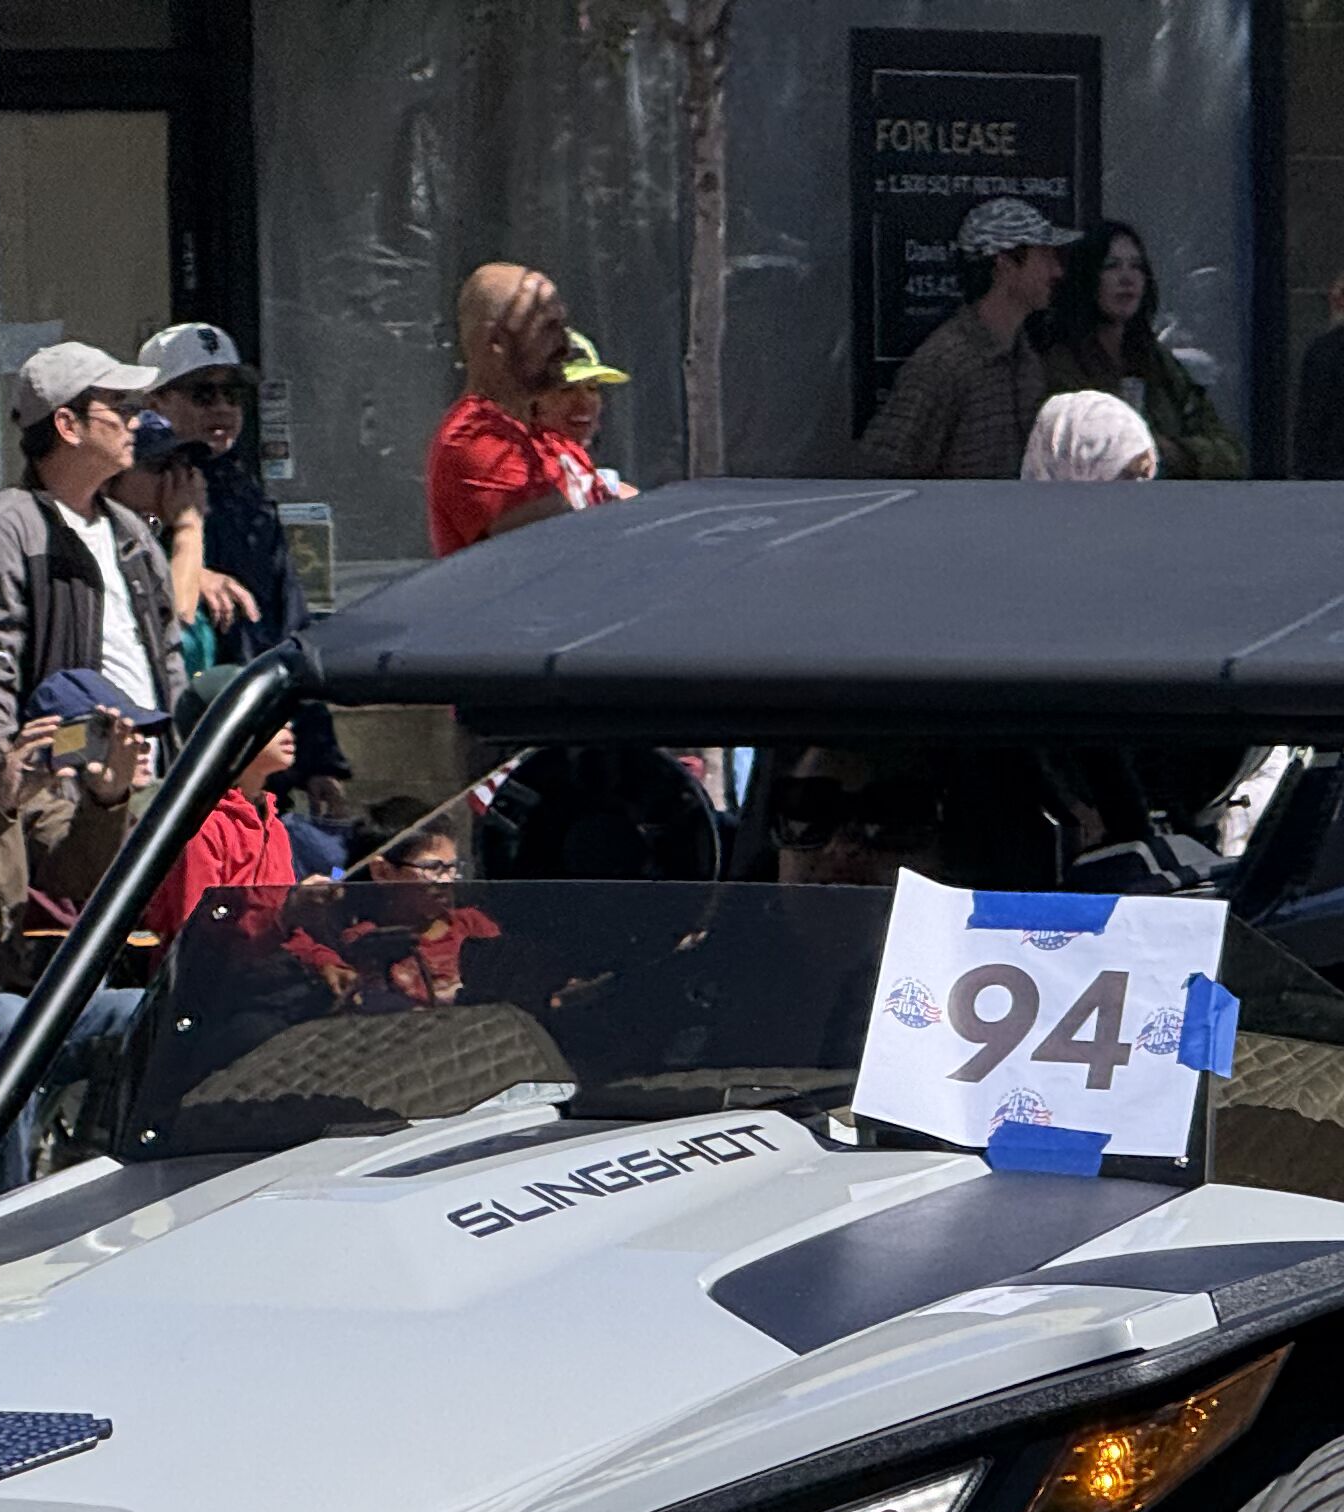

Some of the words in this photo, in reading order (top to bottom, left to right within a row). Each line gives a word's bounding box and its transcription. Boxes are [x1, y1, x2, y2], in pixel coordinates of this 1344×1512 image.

[876, 119, 934, 154] FOR
[937, 120, 1017, 156] LEASE
[893, 999, 928, 1017] JULY
[946, 963, 1132, 1091] 94
[446, 1124, 781, 1239] SLINGSHOT
